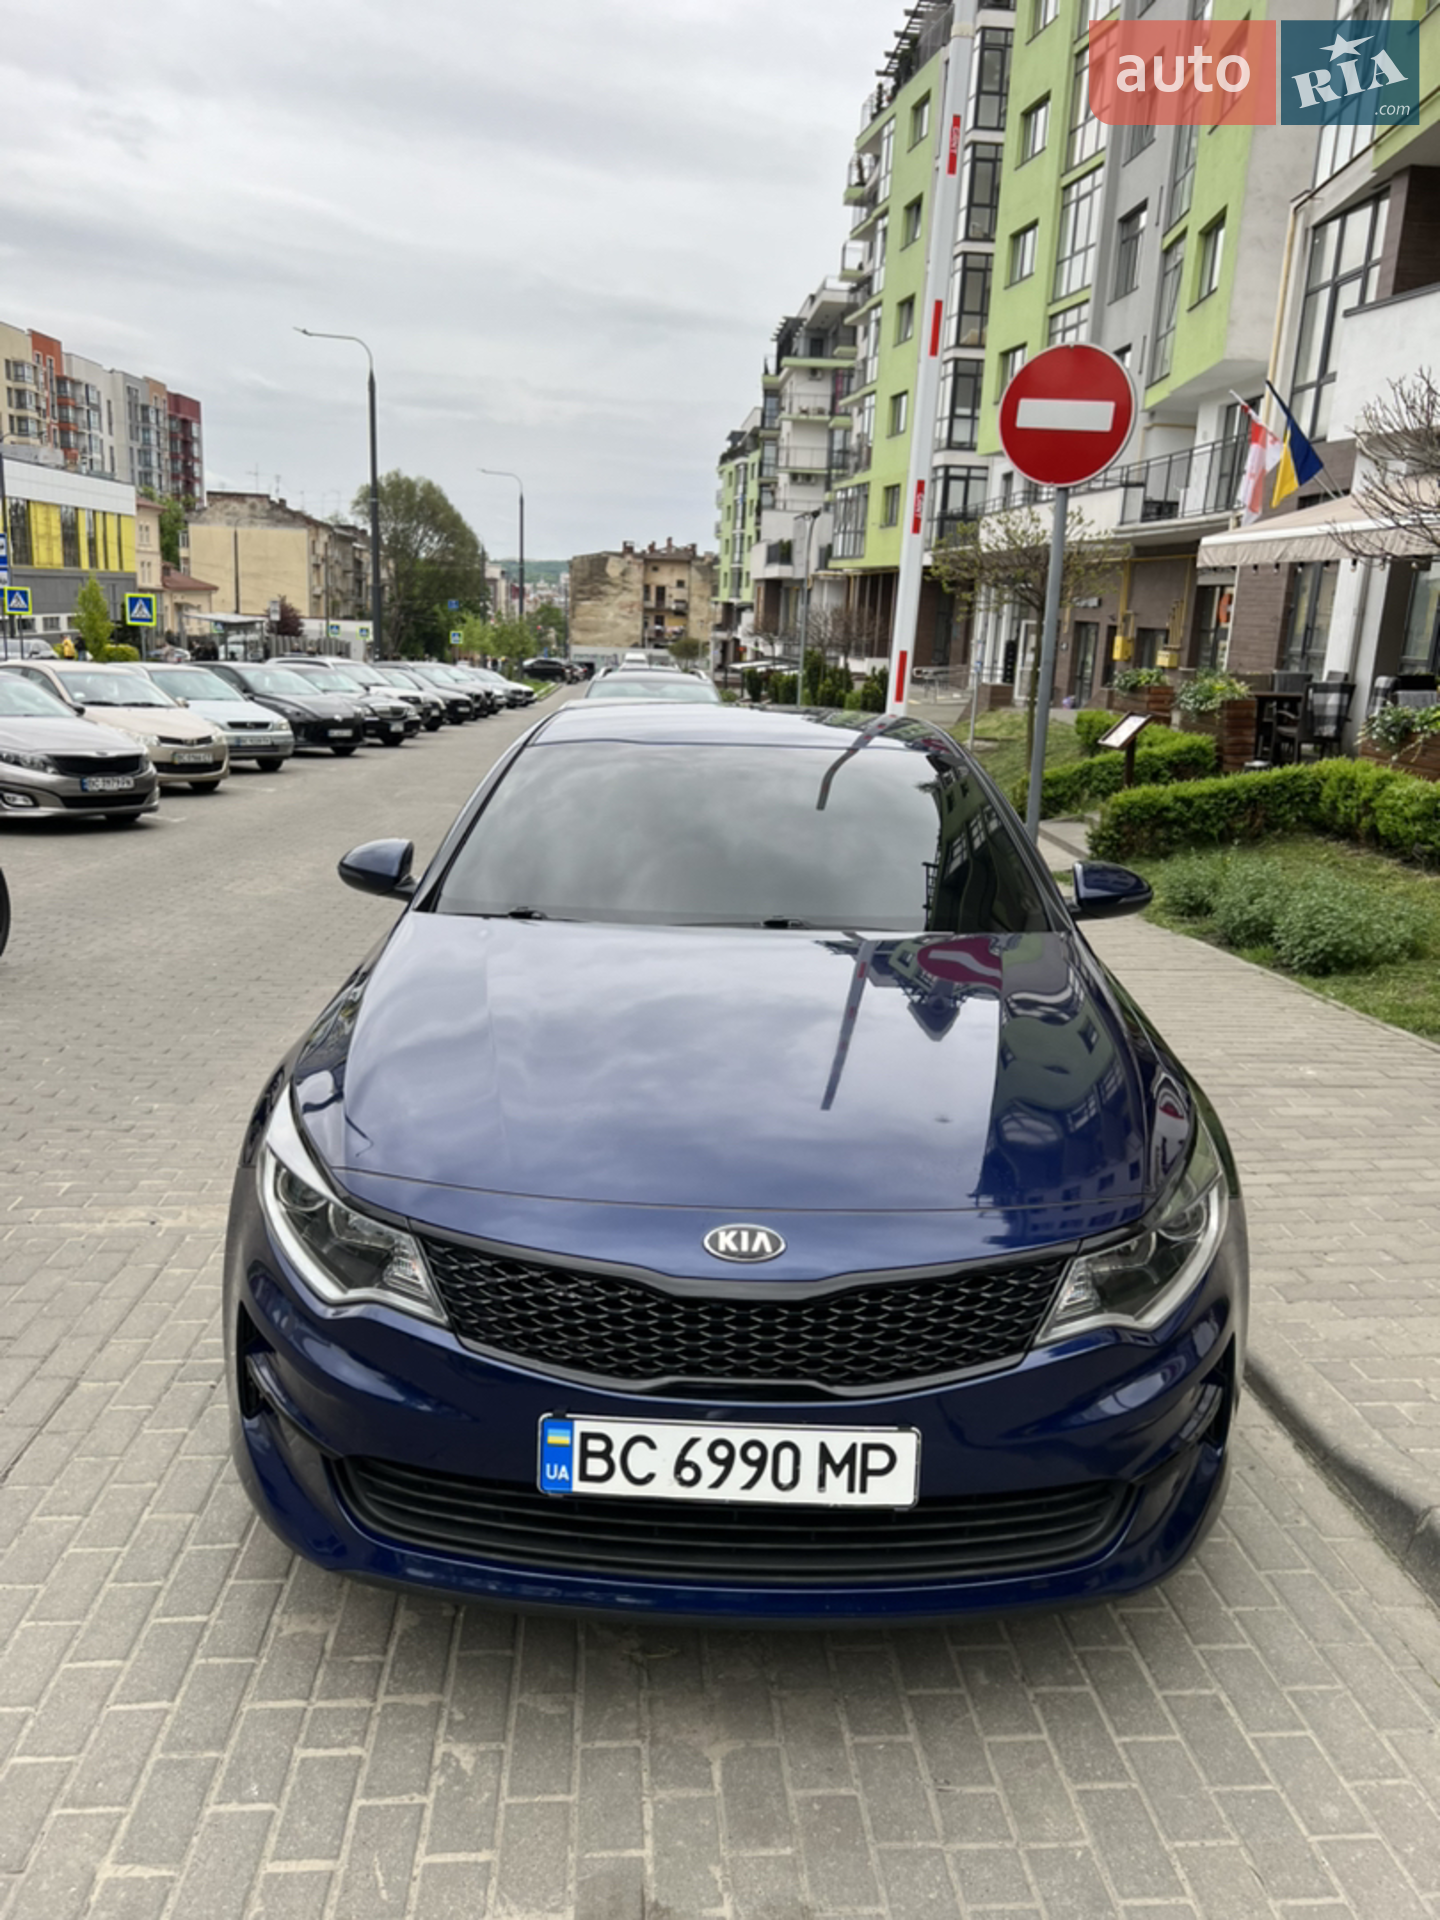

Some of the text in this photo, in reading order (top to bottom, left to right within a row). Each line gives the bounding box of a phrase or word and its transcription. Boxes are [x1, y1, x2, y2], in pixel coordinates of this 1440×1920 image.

[718, 1230, 773, 1253] KIA
[546, 1464, 569, 1481] UA
[579, 1431, 897, 1494] BC 6990 MP
